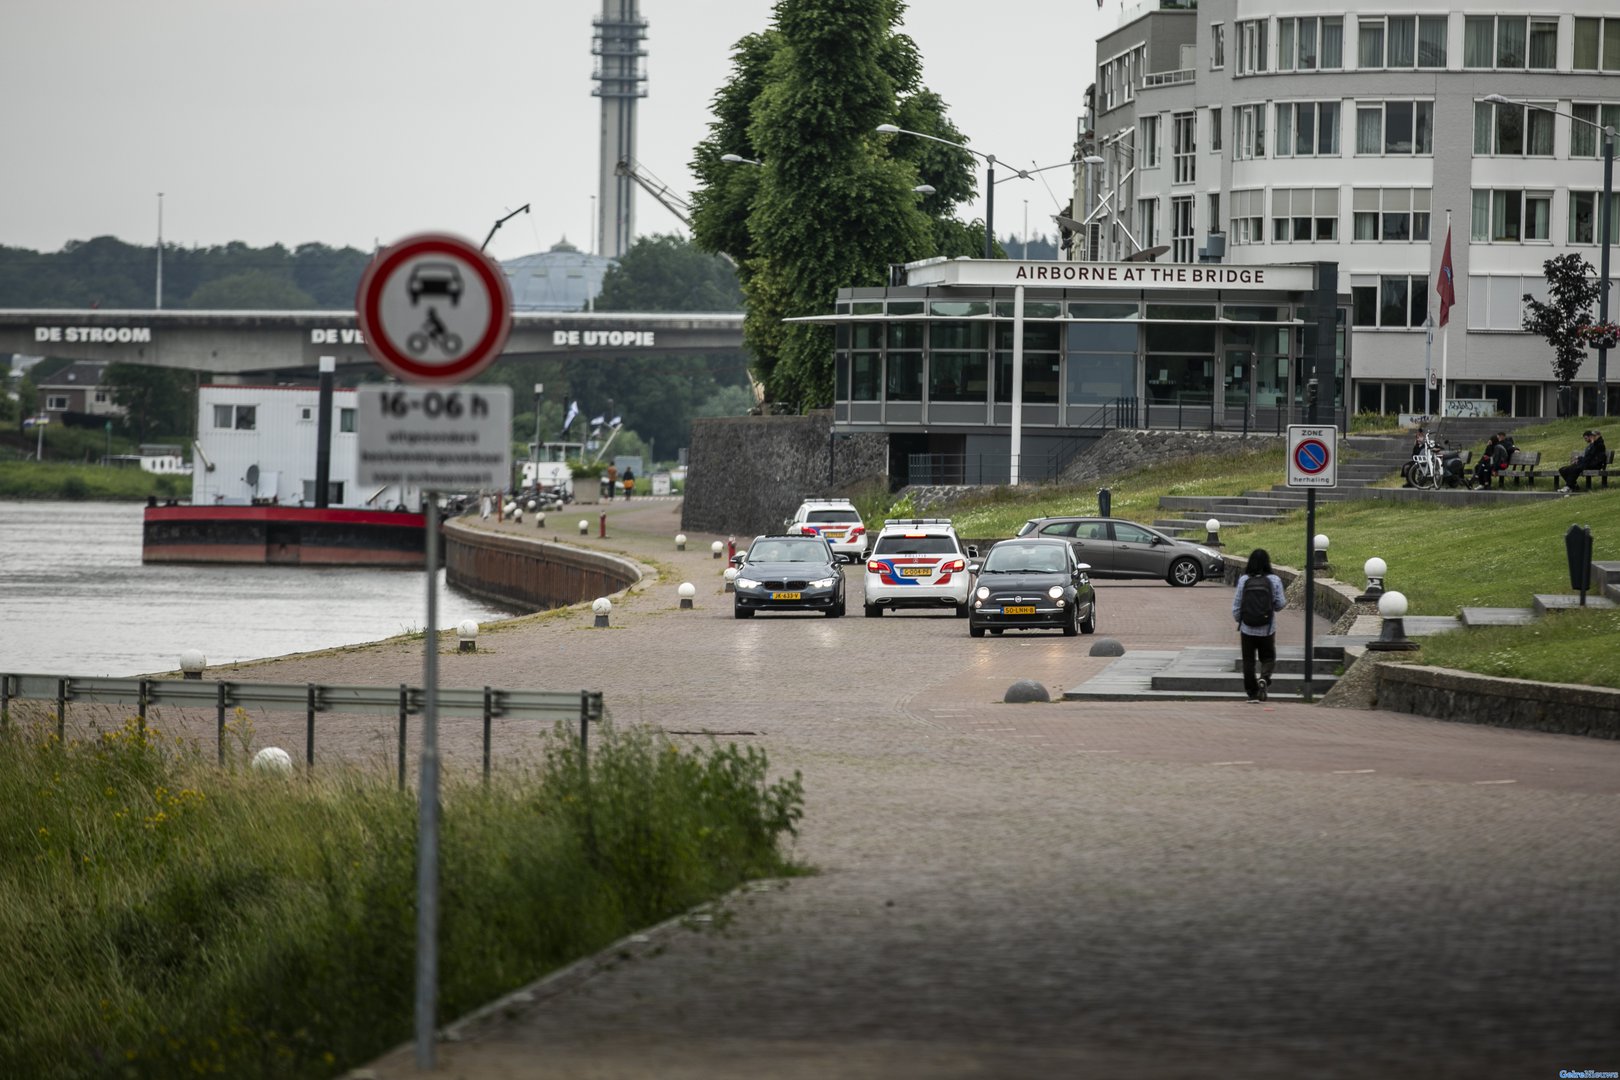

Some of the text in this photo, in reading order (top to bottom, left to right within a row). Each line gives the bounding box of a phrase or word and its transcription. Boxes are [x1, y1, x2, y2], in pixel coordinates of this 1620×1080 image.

[1016, 266, 1264, 284] AIRBORNE AT THE BRIDGE
[35, 327, 151, 343] DE STROOM
[311, 329, 338, 344] DE
[553, 330, 655, 346] DE UTOPIE
[380, 391, 489, 418] 16-06 h
